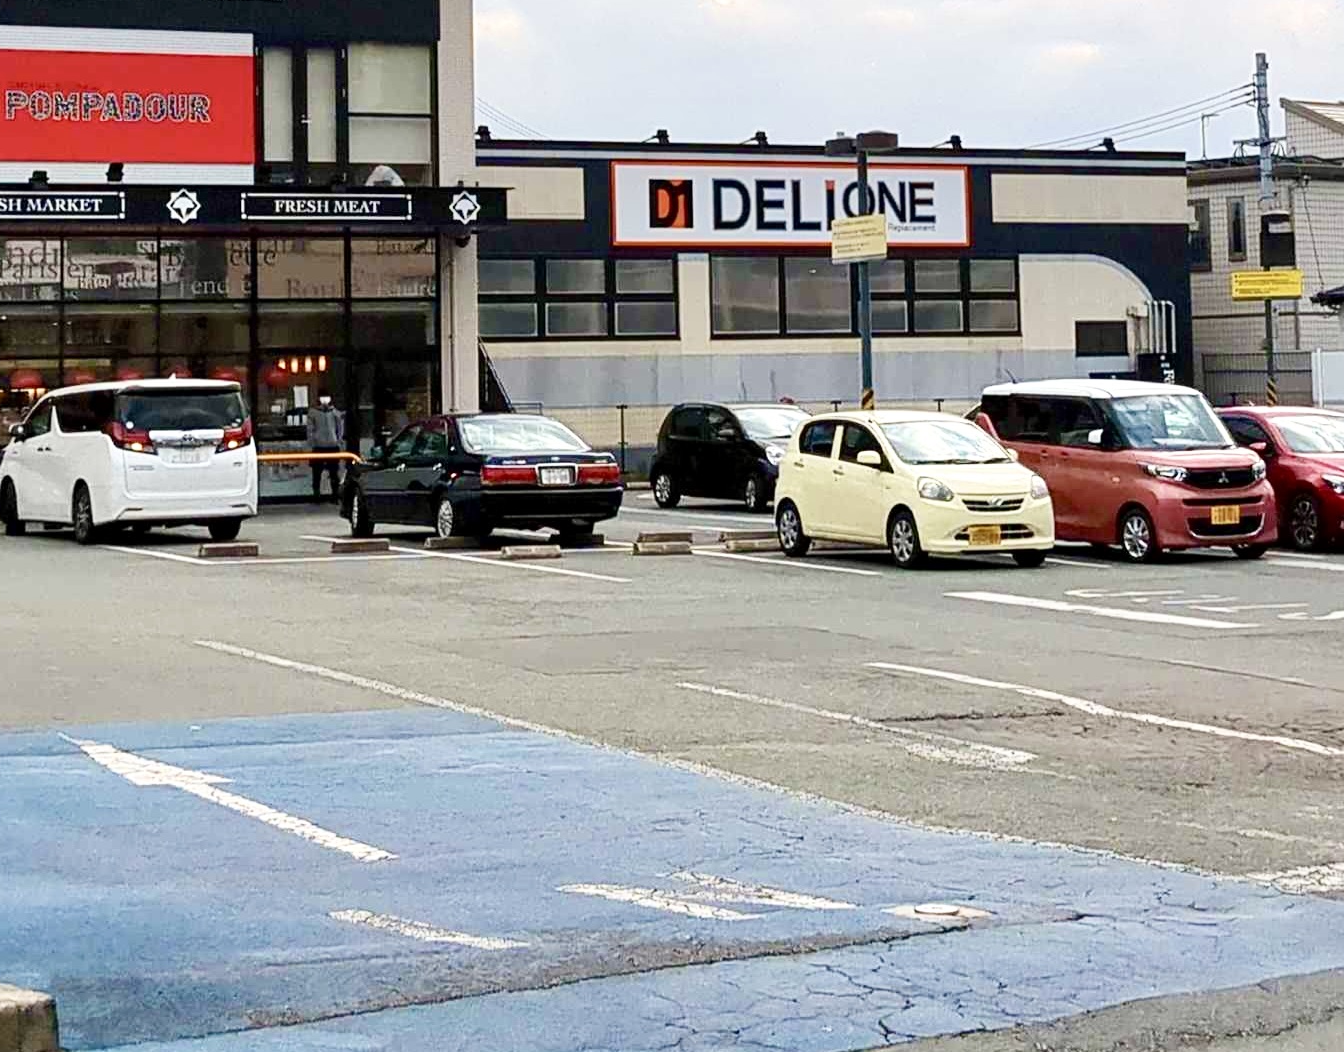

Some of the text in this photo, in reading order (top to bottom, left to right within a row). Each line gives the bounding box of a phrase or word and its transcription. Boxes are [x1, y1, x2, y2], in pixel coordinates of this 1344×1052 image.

[5, 89, 212, 123] POMPADOUR
[25, 198, 103, 213] MARKET
[274, 199, 381, 214] FRESH MEAT
